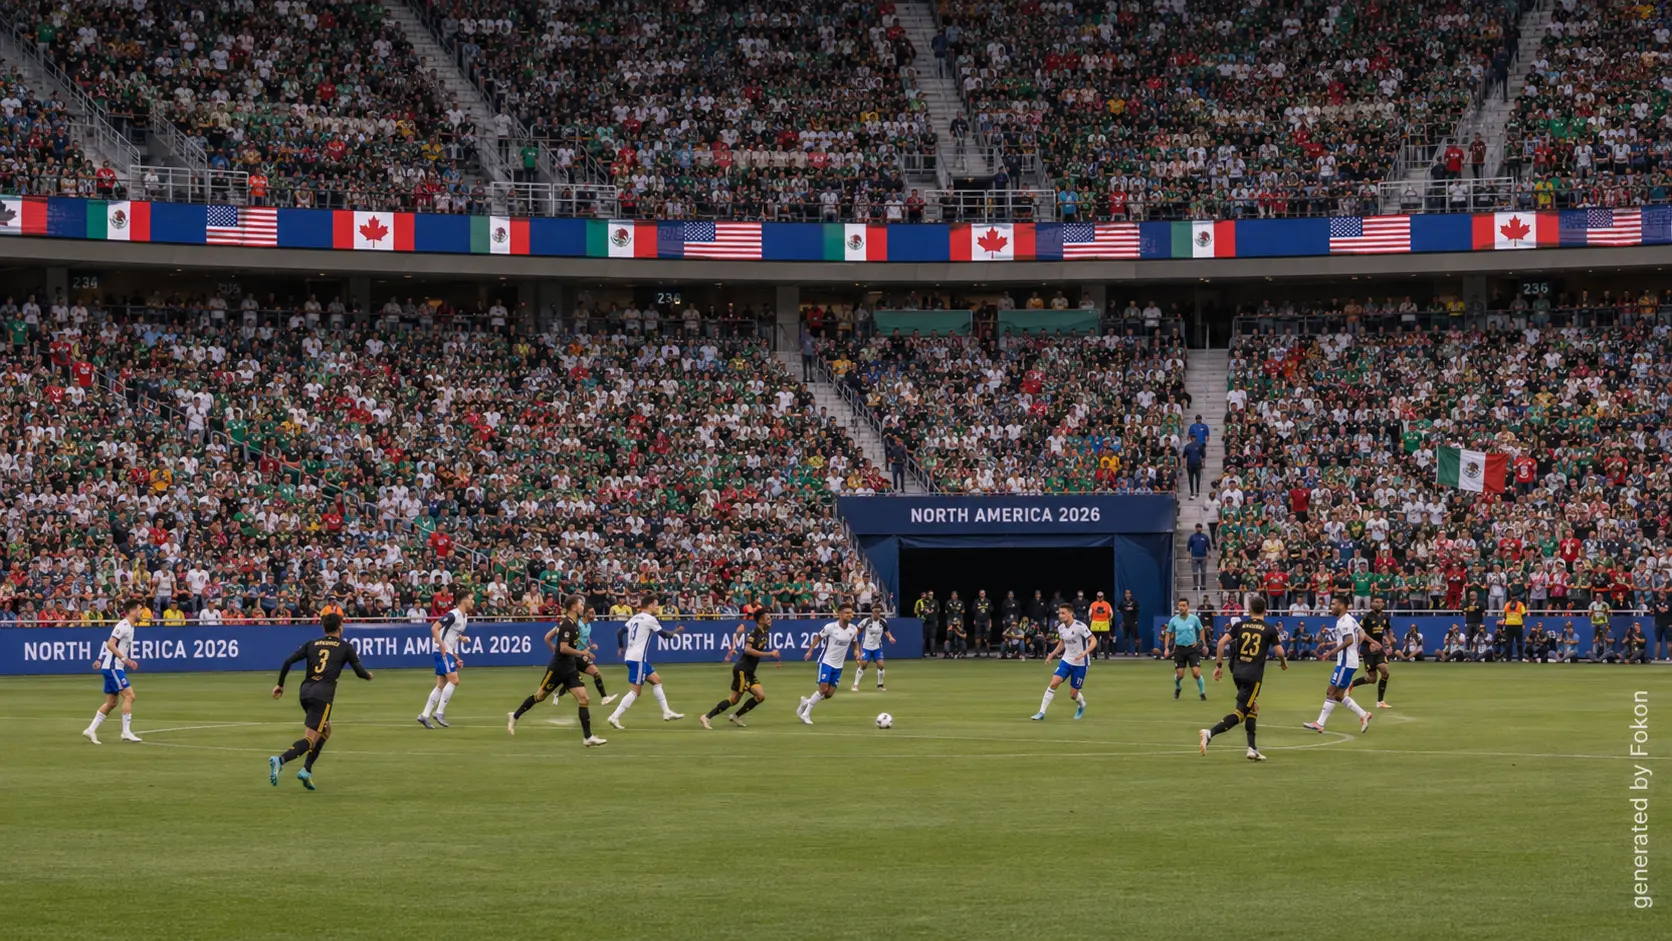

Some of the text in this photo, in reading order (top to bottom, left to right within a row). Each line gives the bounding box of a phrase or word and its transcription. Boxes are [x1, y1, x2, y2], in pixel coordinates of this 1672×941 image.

[1523, 282, 1549, 295] 236
[911, 507, 1100, 523] NORTH AMERICA 2026
[24, 639, 239, 661] NORTH AERICA 2026
[343, 637, 397, 656] ORTH
[489, 635, 532, 654] 2026
[657, 633, 714, 651] NORTH
[720, 632, 796, 650] AMICA
[1240, 632, 1262, 656] 23
[314, 649, 330, 674] 3
